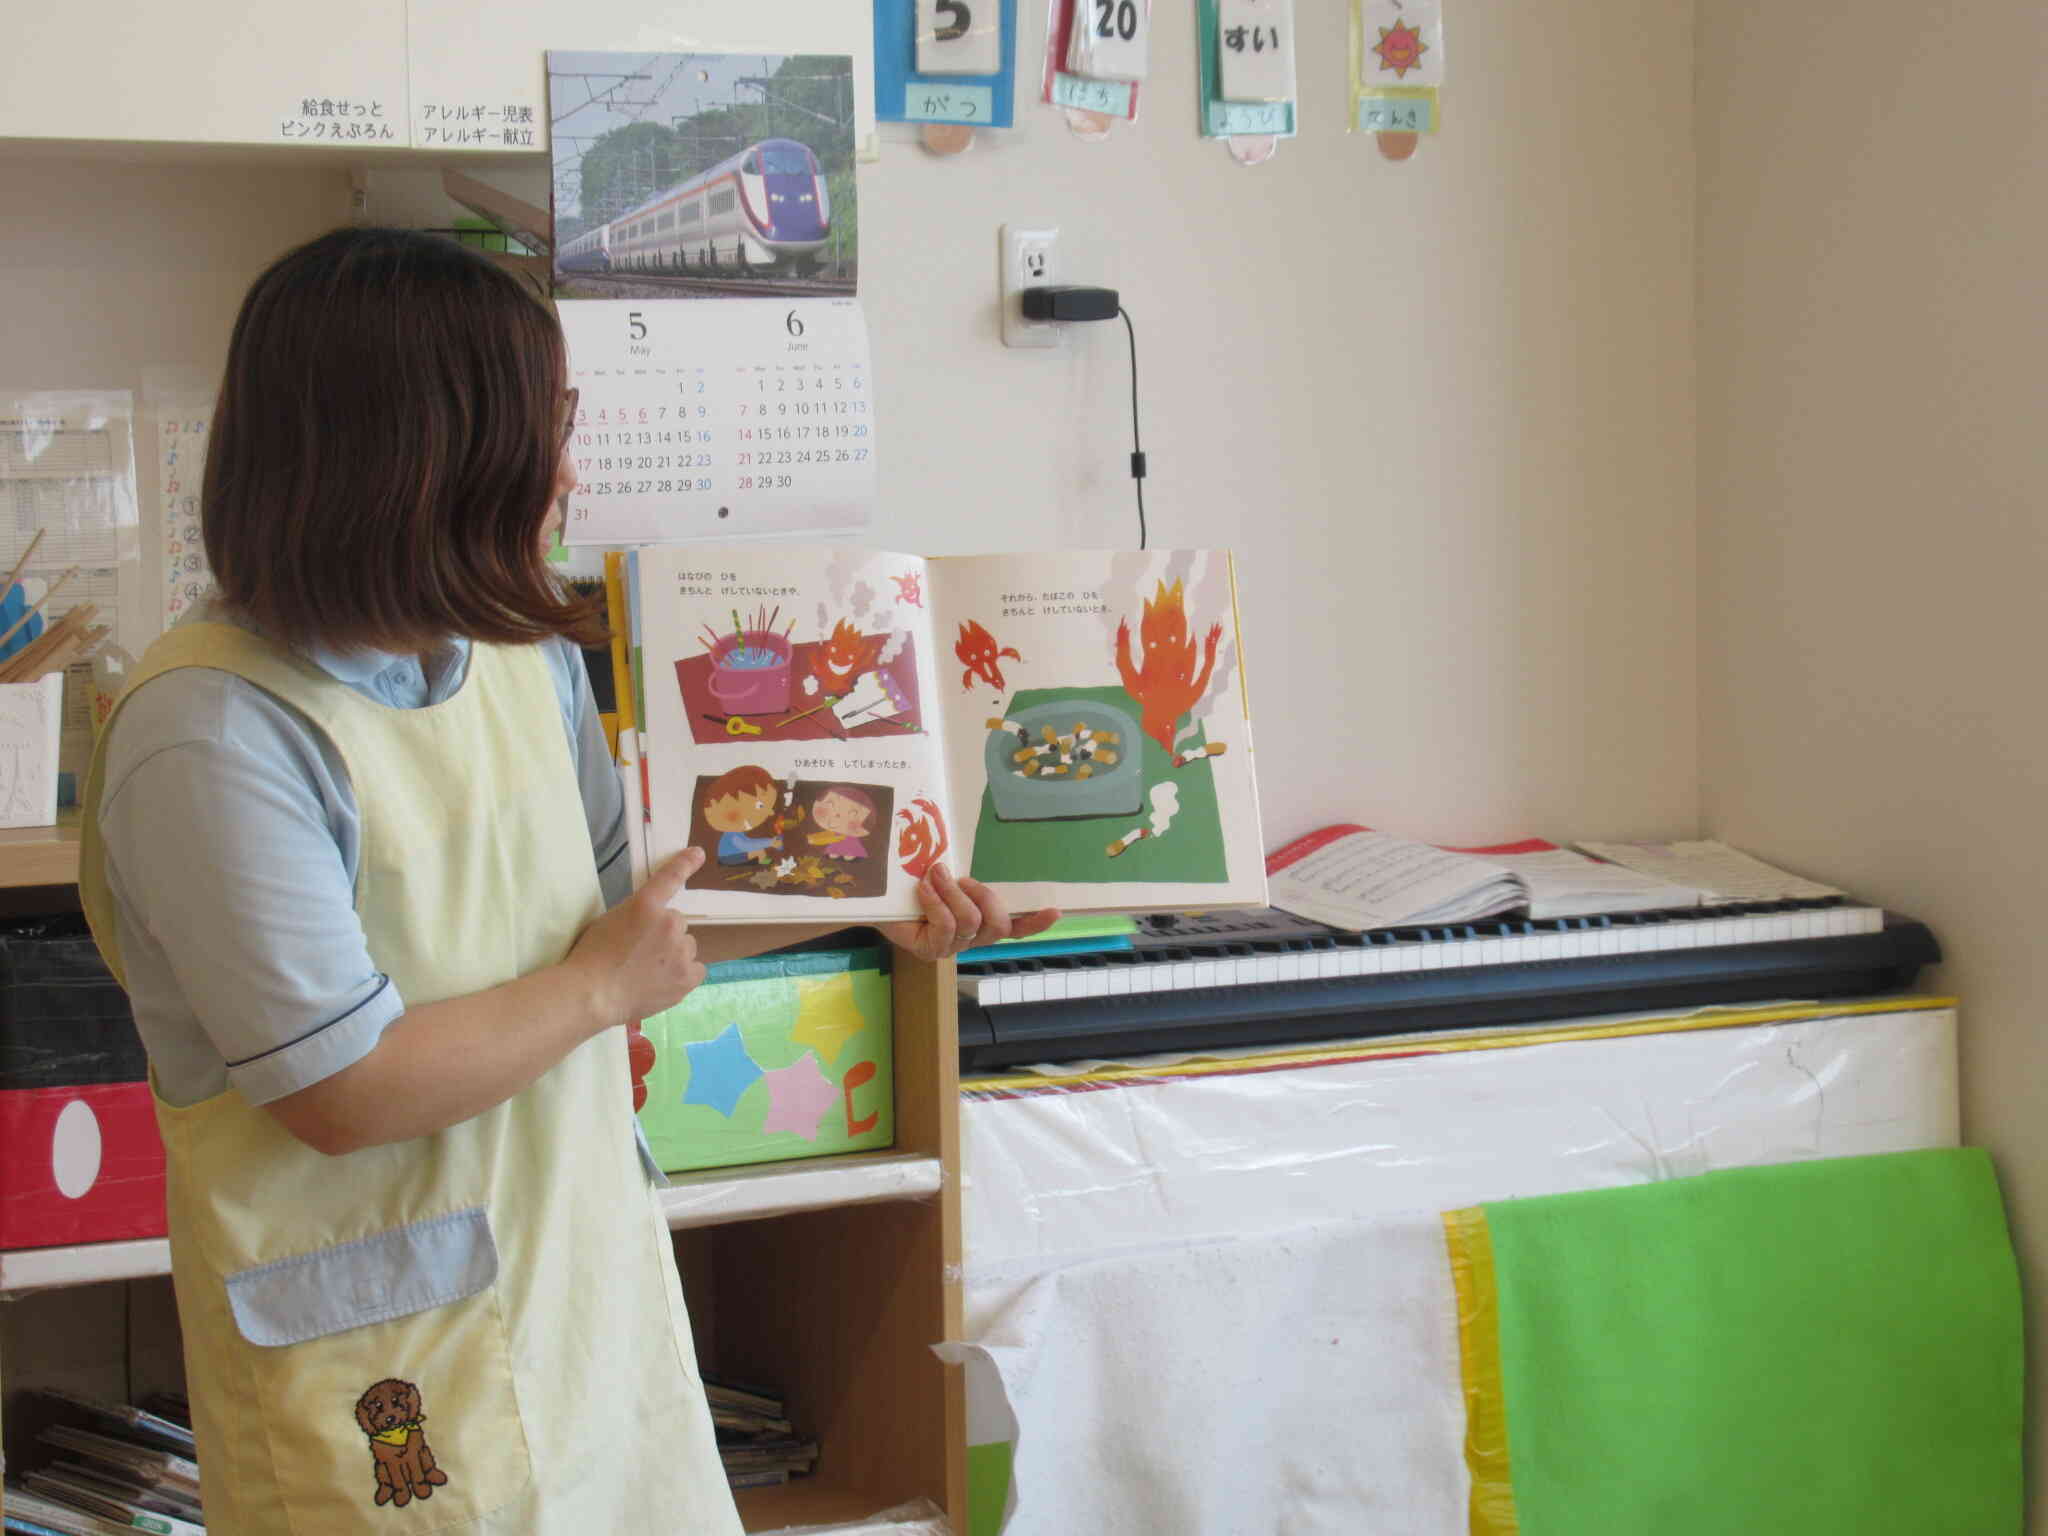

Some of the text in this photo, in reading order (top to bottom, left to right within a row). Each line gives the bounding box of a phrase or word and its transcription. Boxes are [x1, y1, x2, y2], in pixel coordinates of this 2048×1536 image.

[1096, 0, 1137, 40] 20
[1224, 26, 1279, 52] すい
[302, 99, 384, 117] 給食せっと
[923, 97, 976, 117] がつ
[423, 127, 534, 145] アレルギー献立
[629, 312, 647, 340] 5
[786, 309, 804, 337] 6
[630, 345, 651, 357] May
[787, 343, 808, 353] June
[678, 382, 684, 393] 1
[759, 380, 764, 392] 1
[777, 379, 784, 391] 2
[798, 379, 805, 391] 3
[816, 378, 823, 390] 4
[835, 378, 842, 389] 5
[599, 409, 607, 421] 4
[619, 408, 628, 420] 5
[639, 408, 648, 420] 6
[659, 407, 666, 419] 7
[679, 407, 686, 418] 8
[740, 405, 747, 416] 7
[760, 404, 767, 416] 8
[778, 403, 786, 415] 9
[796, 403, 809, 416] 10
[815, 402, 827, 414] 11
[833, 402, 847, 414] 12
[577, 434, 592, 446] 10
[598, 433, 610, 446] 11
[617, 432, 632, 445] 12
[638, 432, 651, 444] 13
[658, 432, 671, 443] 14
[678, 431, 691, 442] 15
[739, 429, 752, 440] 14
[759, 428, 771, 440] 15
[778, 427, 791, 439] 16
[797, 427, 810, 439] 17
[816, 426, 829, 438] 18
[836, 424, 849, 437] 19
[577, 459, 592, 471] 17
[599, 458, 612, 470] 18
[619, 457, 632, 469] 19
[638, 457, 652, 469] 20
[657, 456, 670, 468] 21
[678, 455, 692, 467] 22
[739, 449, 868, 464] 21 22 23 24 25 26 27
[576, 479, 711, 495] 24 25 26 27 28 29 30
[739, 476, 791, 489] 28 29 30
[575, 508, 588, 520] 31
